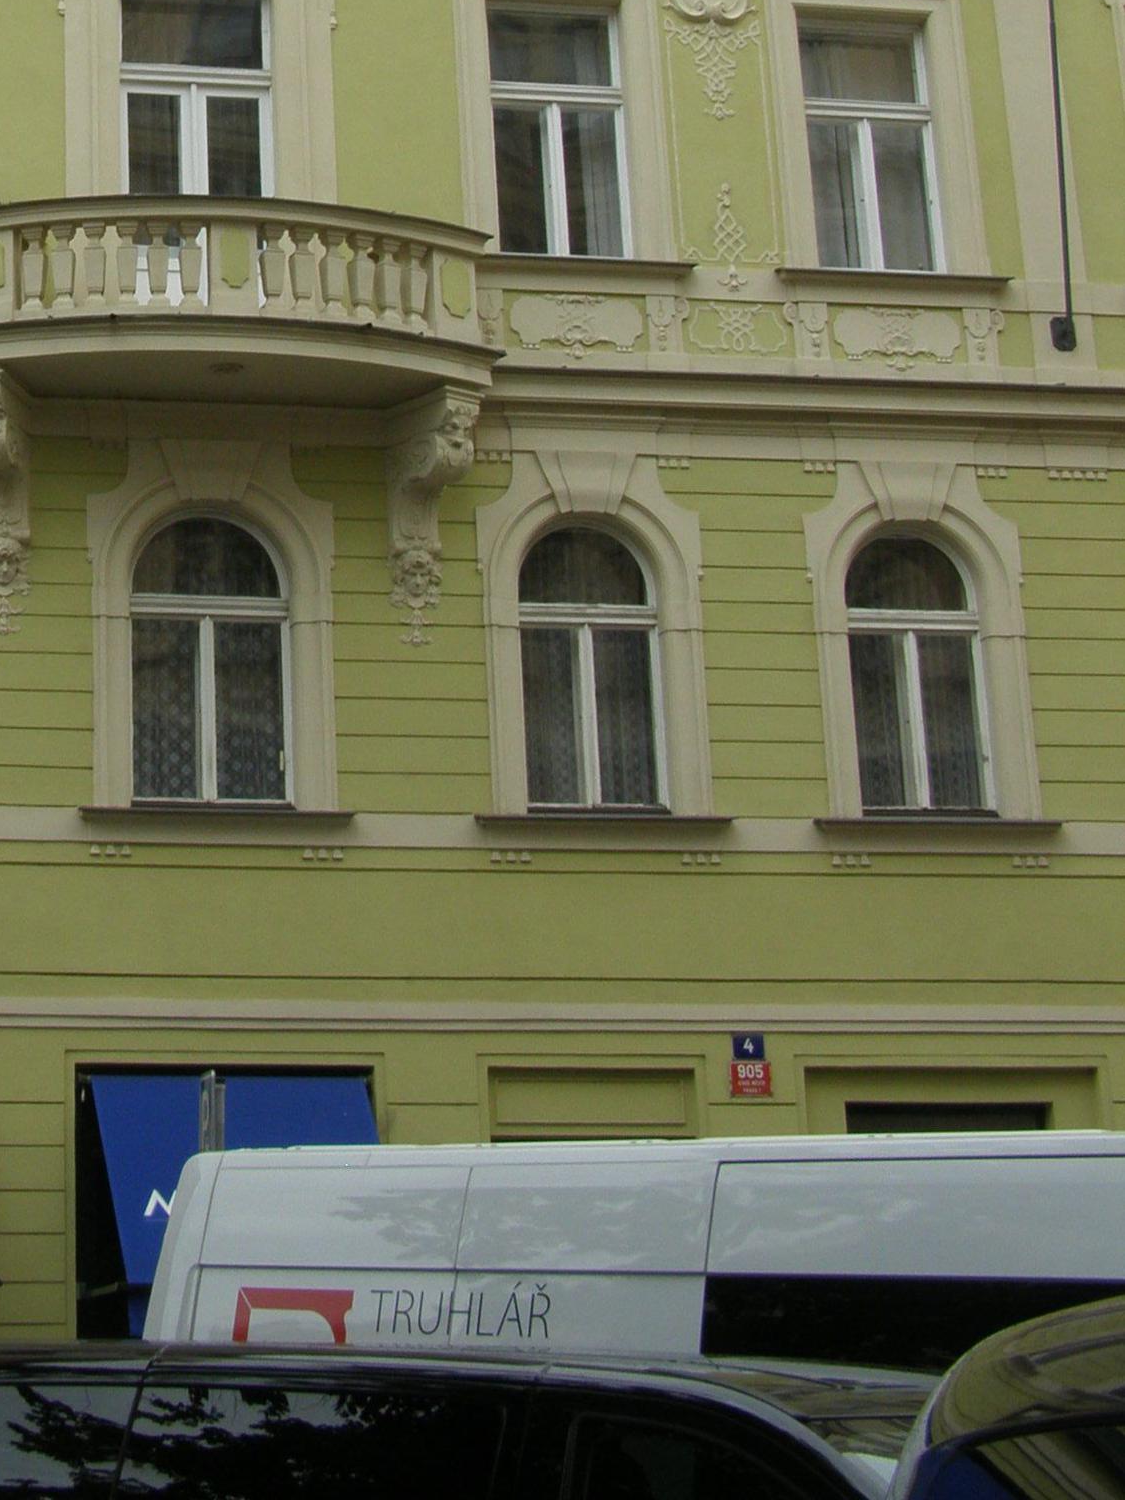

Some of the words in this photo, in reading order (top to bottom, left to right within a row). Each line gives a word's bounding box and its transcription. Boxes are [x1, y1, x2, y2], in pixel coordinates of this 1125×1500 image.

[743, 1037, 754, 1054] 4
[737, 1064, 764, 1078] 905
[371, 1281, 551, 1338] TRUHLÁŘ
